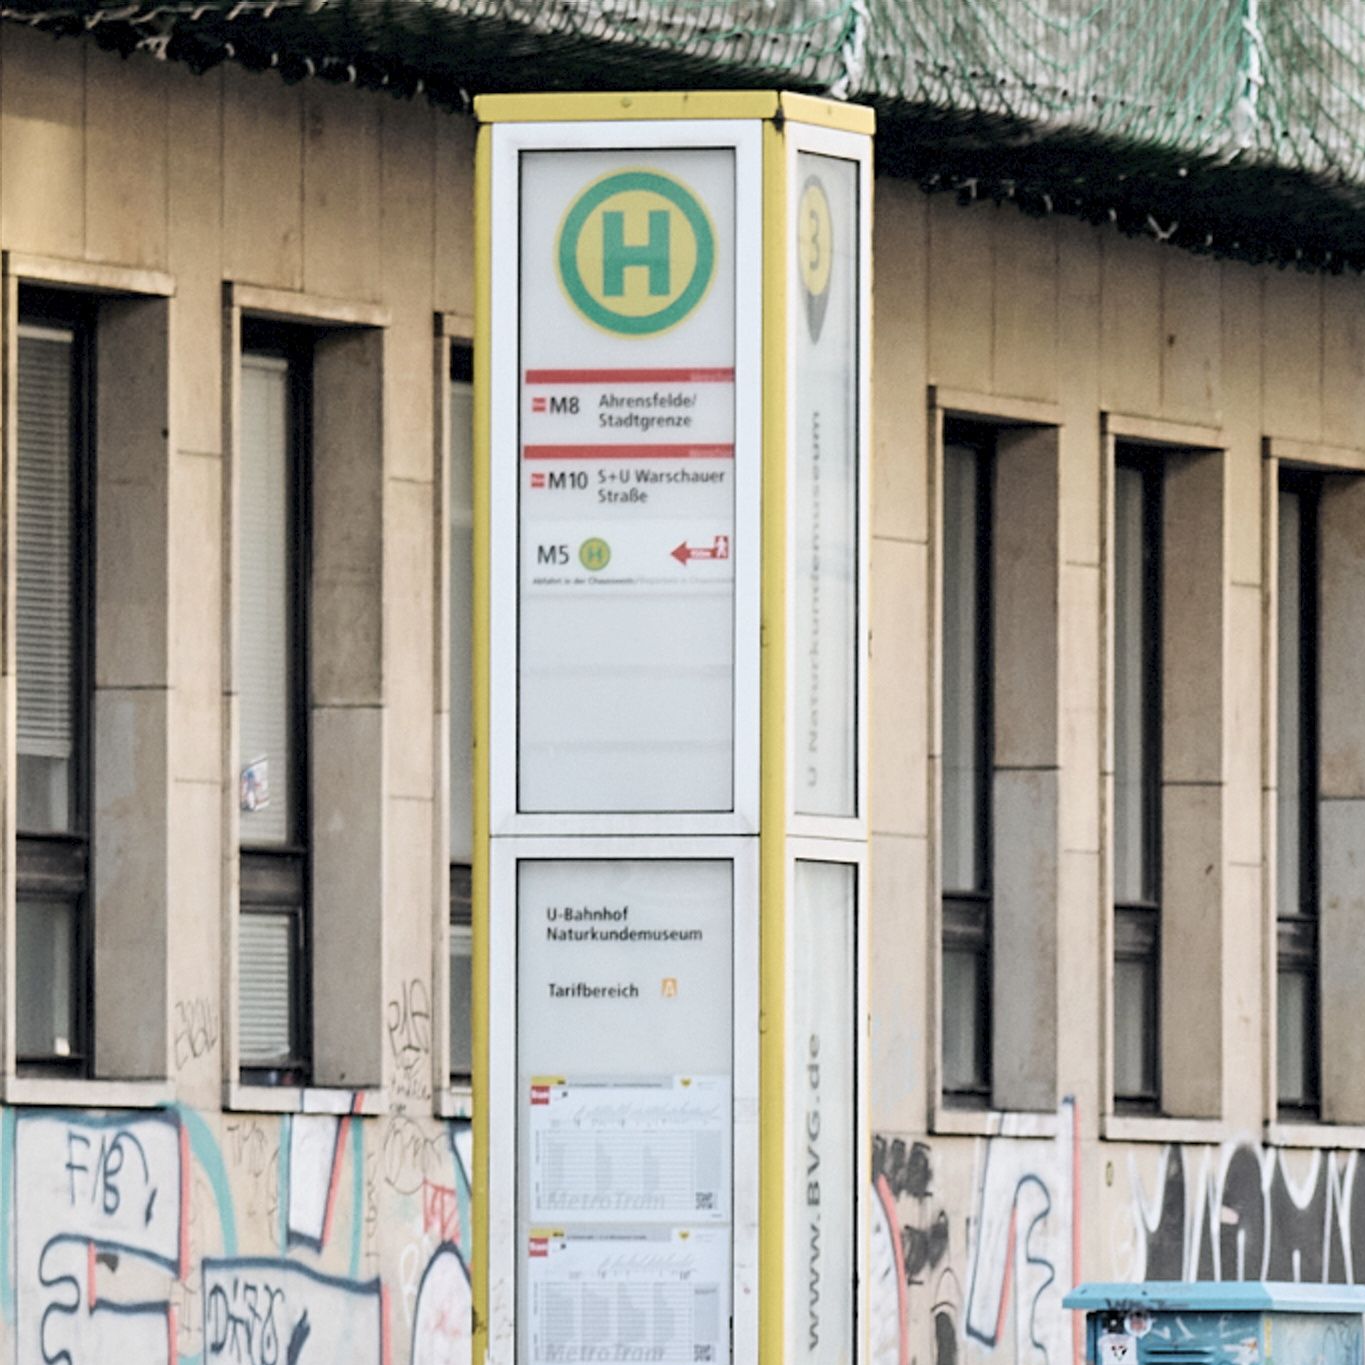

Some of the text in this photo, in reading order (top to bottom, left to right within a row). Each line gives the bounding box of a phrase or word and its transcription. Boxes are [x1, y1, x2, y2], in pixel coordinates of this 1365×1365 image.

[603, 211, 671, 297] H
[549, 397, 581, 415] M8
[598, 412, 693, 431] Stadtgrenze
[548, 471, 589, 490] M10
[635, 468, 726, 484] Warschauer
[597, 487, 649, 504] Straße
[537, 545, 571, 565] M5
[546, 905, 629, 922] U-Bahnhof
[546, 926, 703, 942] Naturkundemuseum
[548, 982, 640, 998] Tarifbereich
[805, 1033, 822, 1353] www.BVG.de
